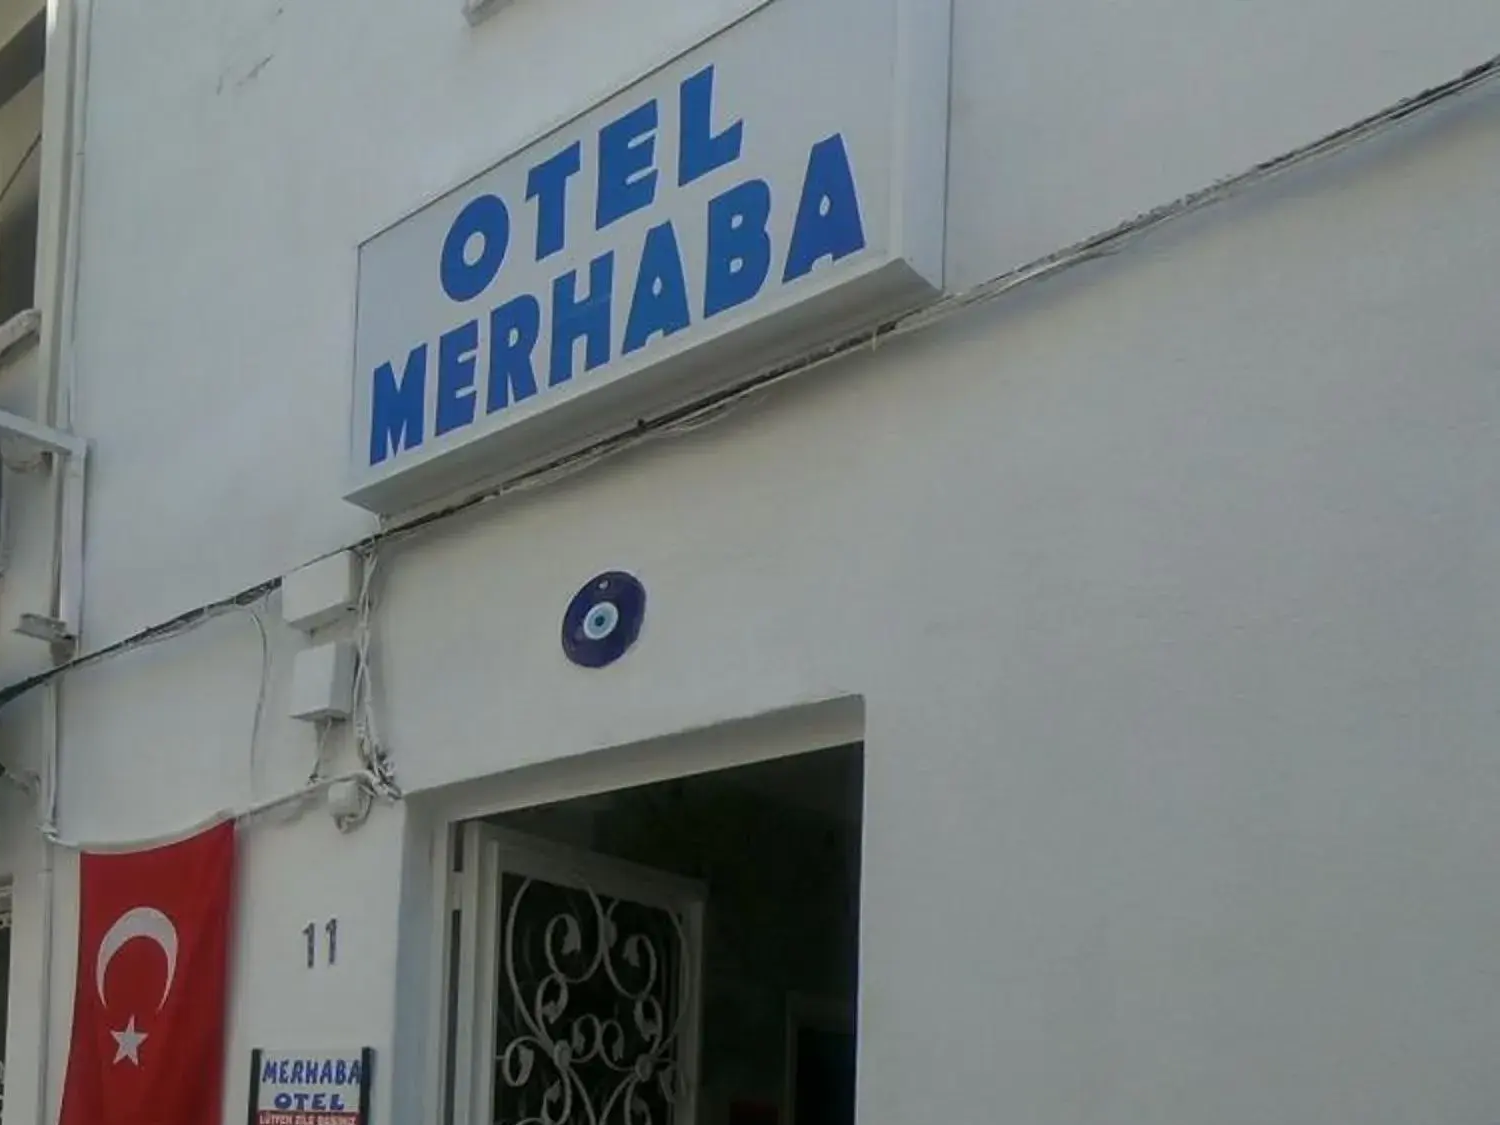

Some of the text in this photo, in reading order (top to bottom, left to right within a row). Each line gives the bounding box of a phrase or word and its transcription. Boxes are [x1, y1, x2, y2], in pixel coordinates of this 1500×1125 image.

[439, 63, 743, 302] OTEL
[369, 132, 866, 467] MERHABA
[302, 918, 338, 969] 11
[262, 1057, 362, 1086] MERHABA
[274, 1092, 345, 1111] OTEL
